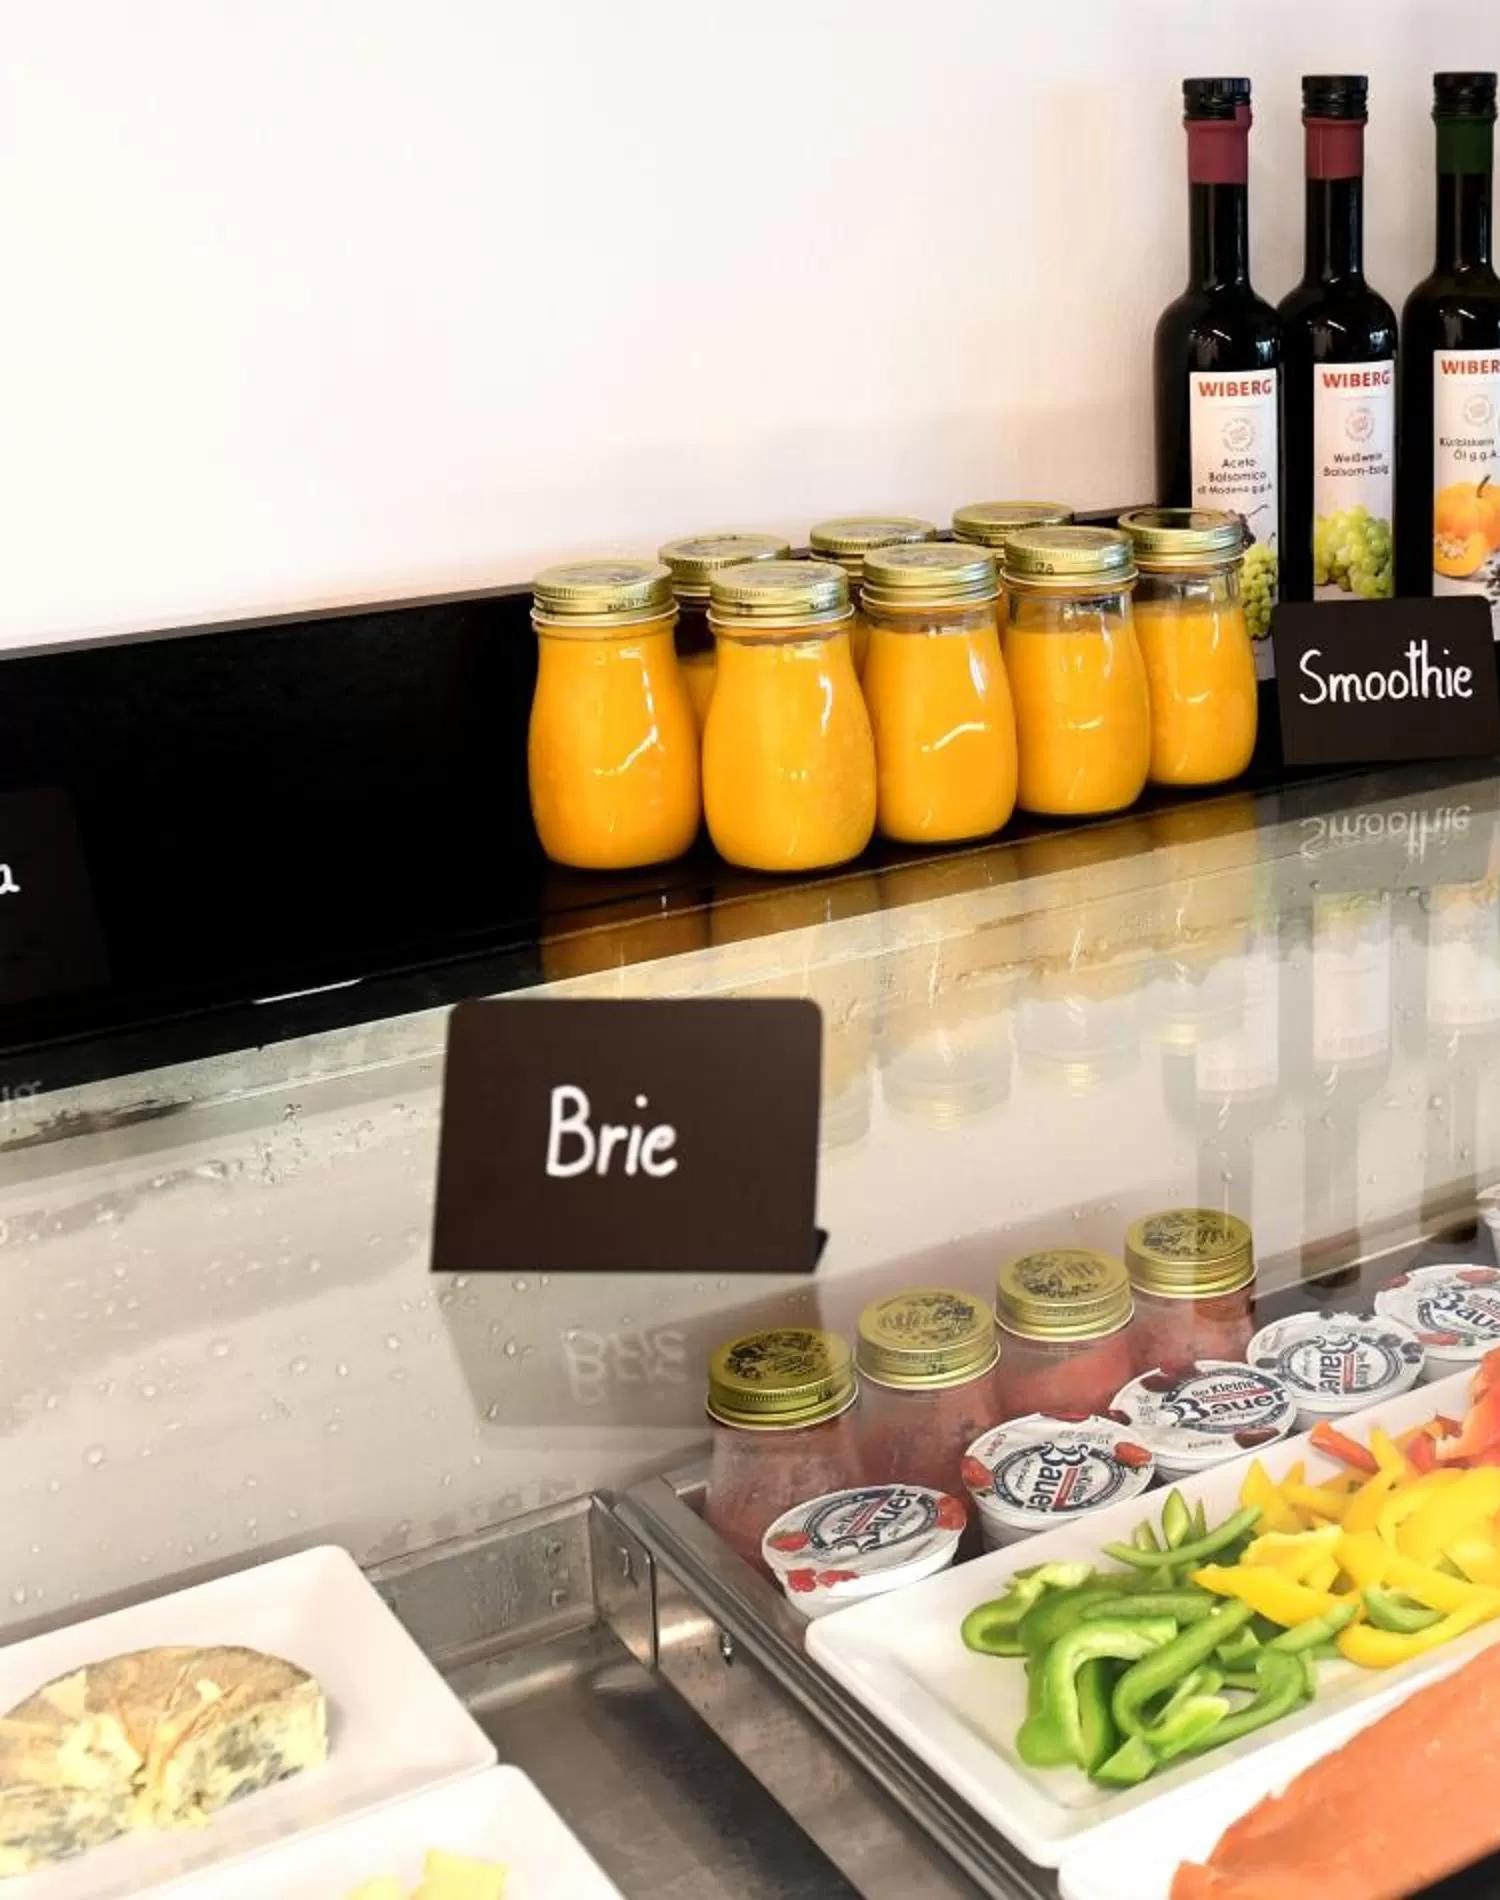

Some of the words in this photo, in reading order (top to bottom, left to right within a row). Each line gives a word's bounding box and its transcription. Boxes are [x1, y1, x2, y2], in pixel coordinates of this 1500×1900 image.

[1199, 379, 1272, 397] WIBERG
[1322, 370, 1391, 388] WIBERG
[1221, 457, 1257, 469] Aceto
[1299, 638, 1474, 705] Smoothie
[545, 1083, 678, 1178] Brie
[1209, 1378, 1257, 1395] Kleine
[1314, 1333, 1359, 1395] Bauer
[1164, 1388, 1288, 1426] Bauer
[1026, 1440, 1089, 1513] Bauer
[831, 1488, 918, 1554] Bauer
